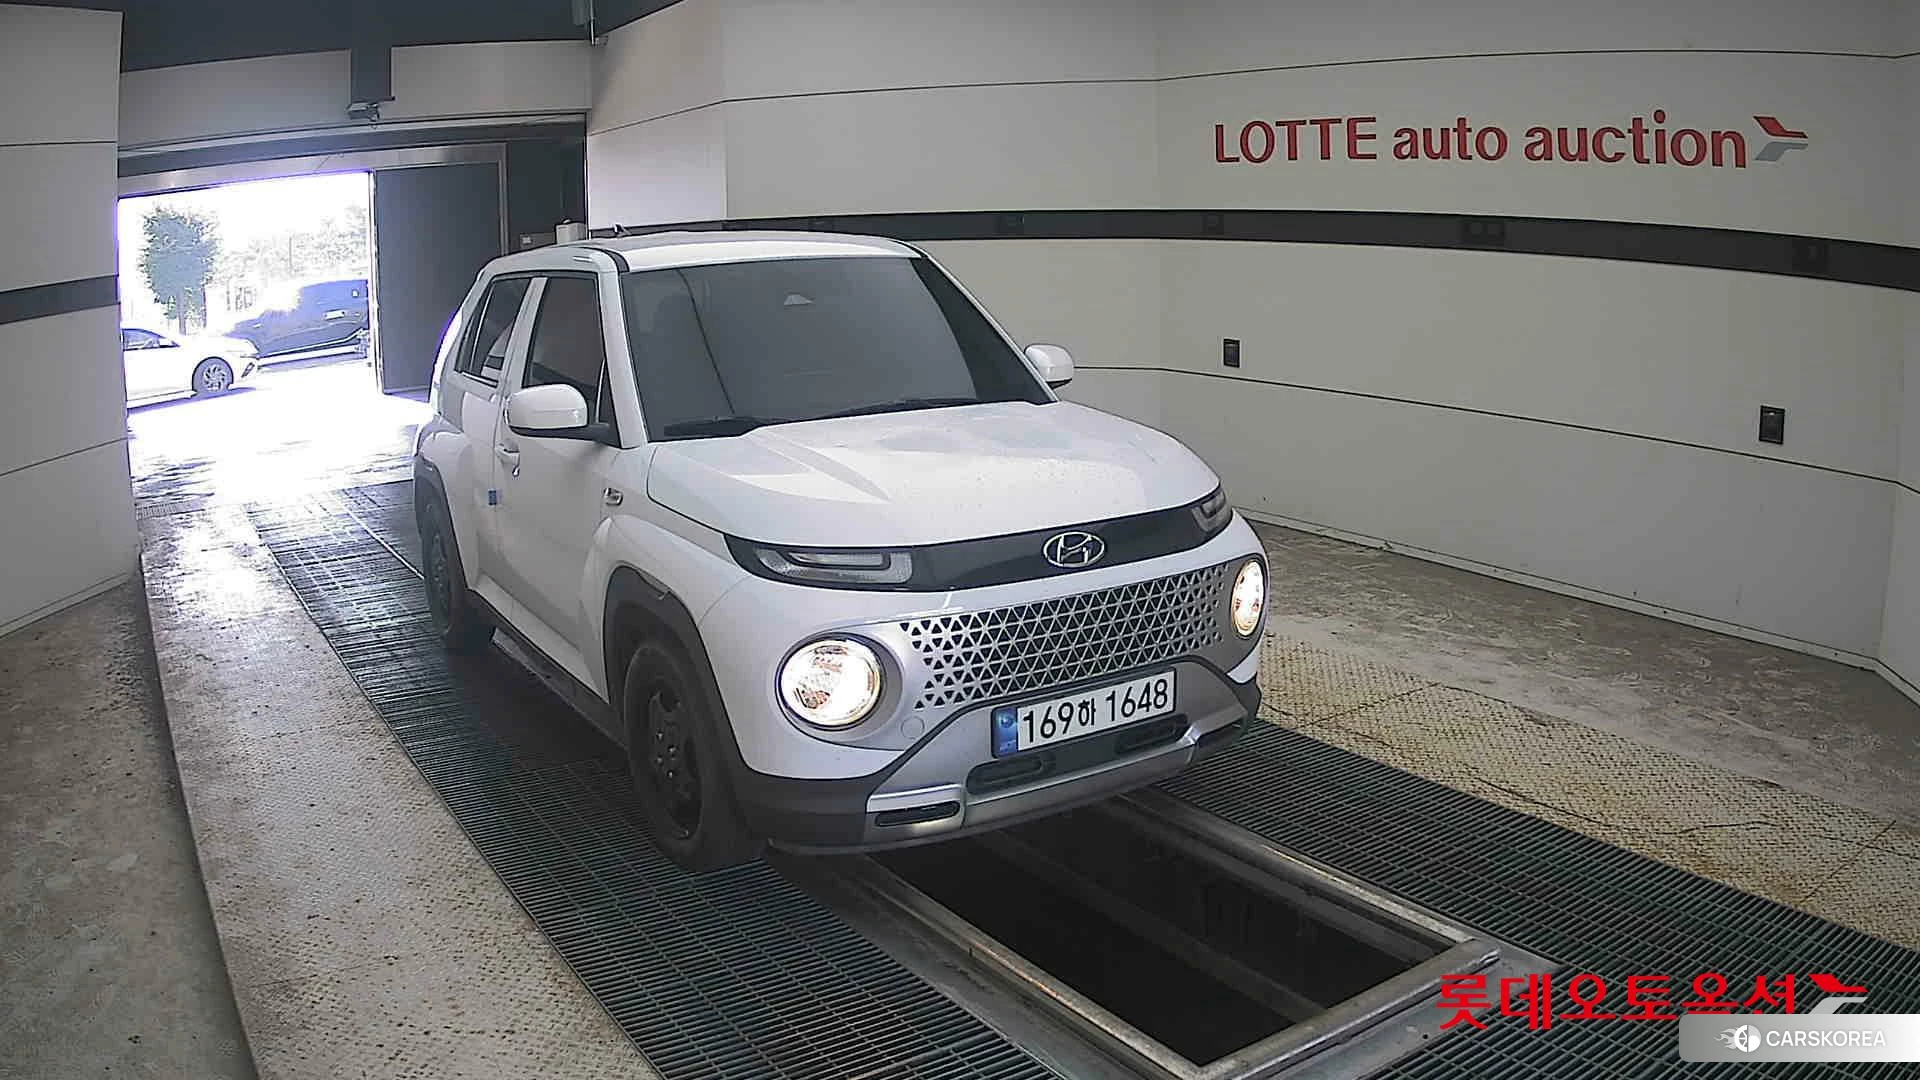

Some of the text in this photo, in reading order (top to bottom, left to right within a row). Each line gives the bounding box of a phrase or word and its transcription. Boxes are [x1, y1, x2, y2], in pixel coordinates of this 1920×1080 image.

[1214, 109, 1746, 168] LOTTE auto auction
[1022, 678, 1168, 743] 169하 1648
